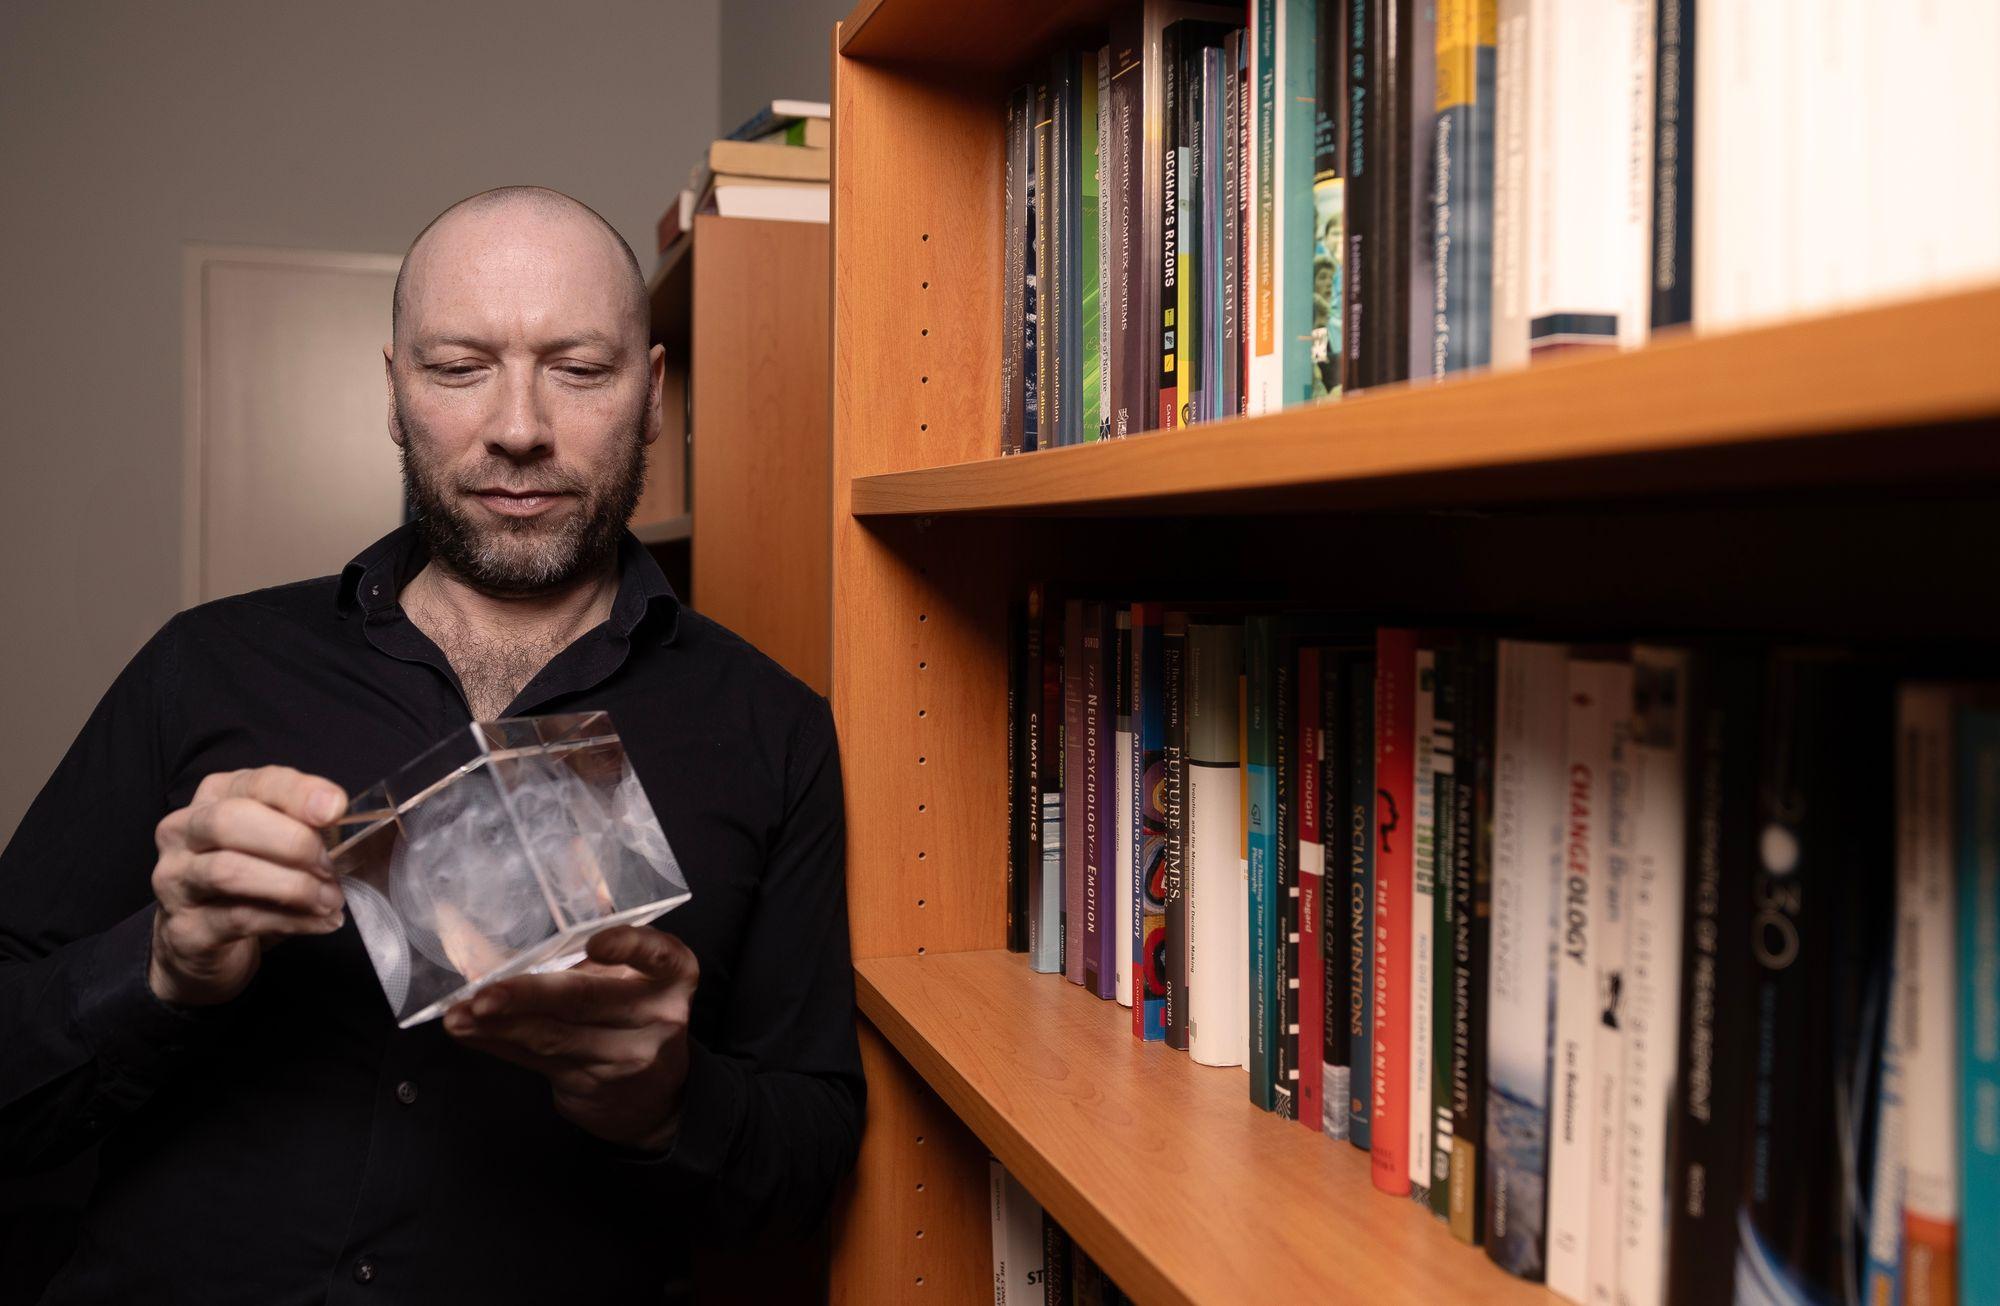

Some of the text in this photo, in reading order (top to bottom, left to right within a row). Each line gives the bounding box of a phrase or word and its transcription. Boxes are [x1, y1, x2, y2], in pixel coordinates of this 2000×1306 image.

[1263, 69, 1273, 99] The
[1192, 120, 1201, 178] Simplicity
[1263, 101, 1272, 183] Foundations
[1351, 86, 1366, 178] ANALYSIS
[1102, 188, 1108, 199] of
[1165, 149, 1175, 226] OCKHAM'S
[1225, 74, 1234, 341] BAYES OR BUST? EARMAN
[1263, 184, 1272, 199] of
[1436, 205, 1450, 233] the
[1165, 228, 1175, 288] RAZORS
[1261, 202, 1272, 285] Econometric
[1434, 235, 1450, 312] Structure
[1087, 695, 1098, 842] NEUROPSYCHOLOGY
[1134, 733, 1140, 748] An
[1325, 721, 1336, 787] HISTORY
[1169, 745, 1181, 830] FUTURE
[1326, 791, 1335, 829] AND
[1134, 829, 1140, 841] to
[1278, 801, 1287, 886] Translation
[1304, 727, 1313, 933] HOT THOUGHT Thagard
[1326, 831, 1335, 863] THE
[1456, 784, 1472, 905] PARTIALITY
[1567, 764, 1593, 967] CHANGEOLOGY
[1087, 865, 1097, 933] EMOTION
[1168, 836, 1181, 904] TIMES,
[1325, 866, 1335, 928] FUTURE
[1325, 931, 1335, 955] OF
[1351, 805, 1365, 1037] SOCIAL CONVENTIONS
[1456, 908, 1470, 963] AND
[1324, 959, 1335, 1046] HUMANITY
[1374, 879, 1388, 1119] THE RATIONAL ANIMAL
[1452, 967, 1470, 1119] IMPARTIALITY
